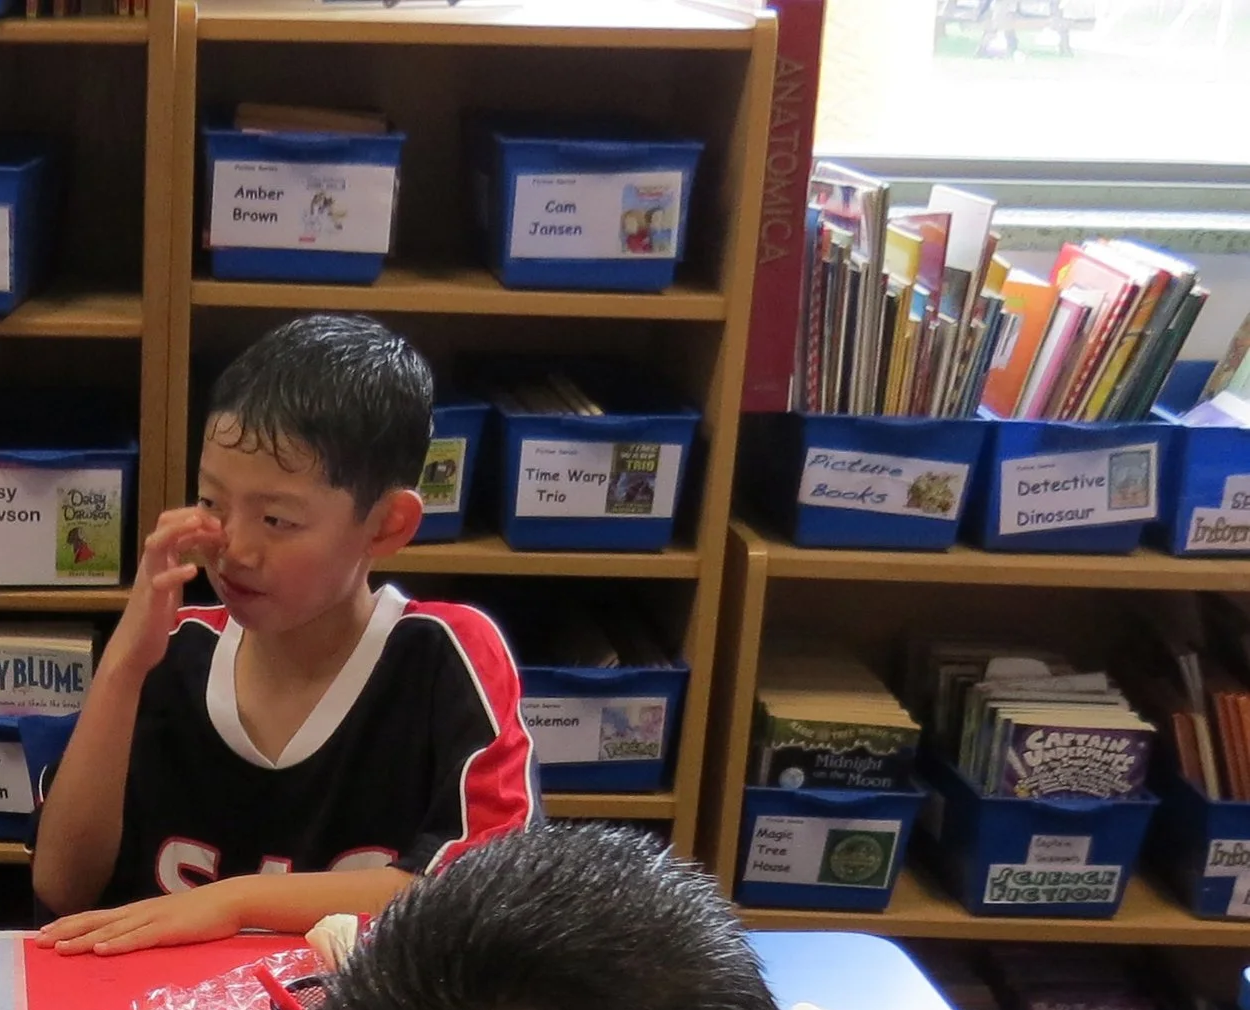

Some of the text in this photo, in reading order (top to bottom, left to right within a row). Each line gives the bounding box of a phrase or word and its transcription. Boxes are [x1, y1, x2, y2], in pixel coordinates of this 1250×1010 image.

[758, 57, 805, 264] ANATOMICA
[234, 185, 284, 201] Amber
[232, 207, 278, 222] Brown
[544, 200, 577, 214] Cam
[528, 221, 583, 236] Jansen
[807, 453, 903, 477] Picture
[524, 468, 607, 486] Time Warp
[1016, 473, 1106, 497] Detective
[536, 489, 567, 503] Trio
[810, 482, 888, 505] Books
[1016, 506, 1095, 527] Dinosaur
[13, 656, 84, 693] BLUME
[814, 754, 883, 773] Midnight
[845, 771, 893, 788] Moon
[756, 827, 793, 842] Magic
[757, 844, 787, 856] Tree
[752, 860, 791, 873] House
[990, 867, 1117, 885] SCIENCE
[988, 881, 1112, 902] FICTION
